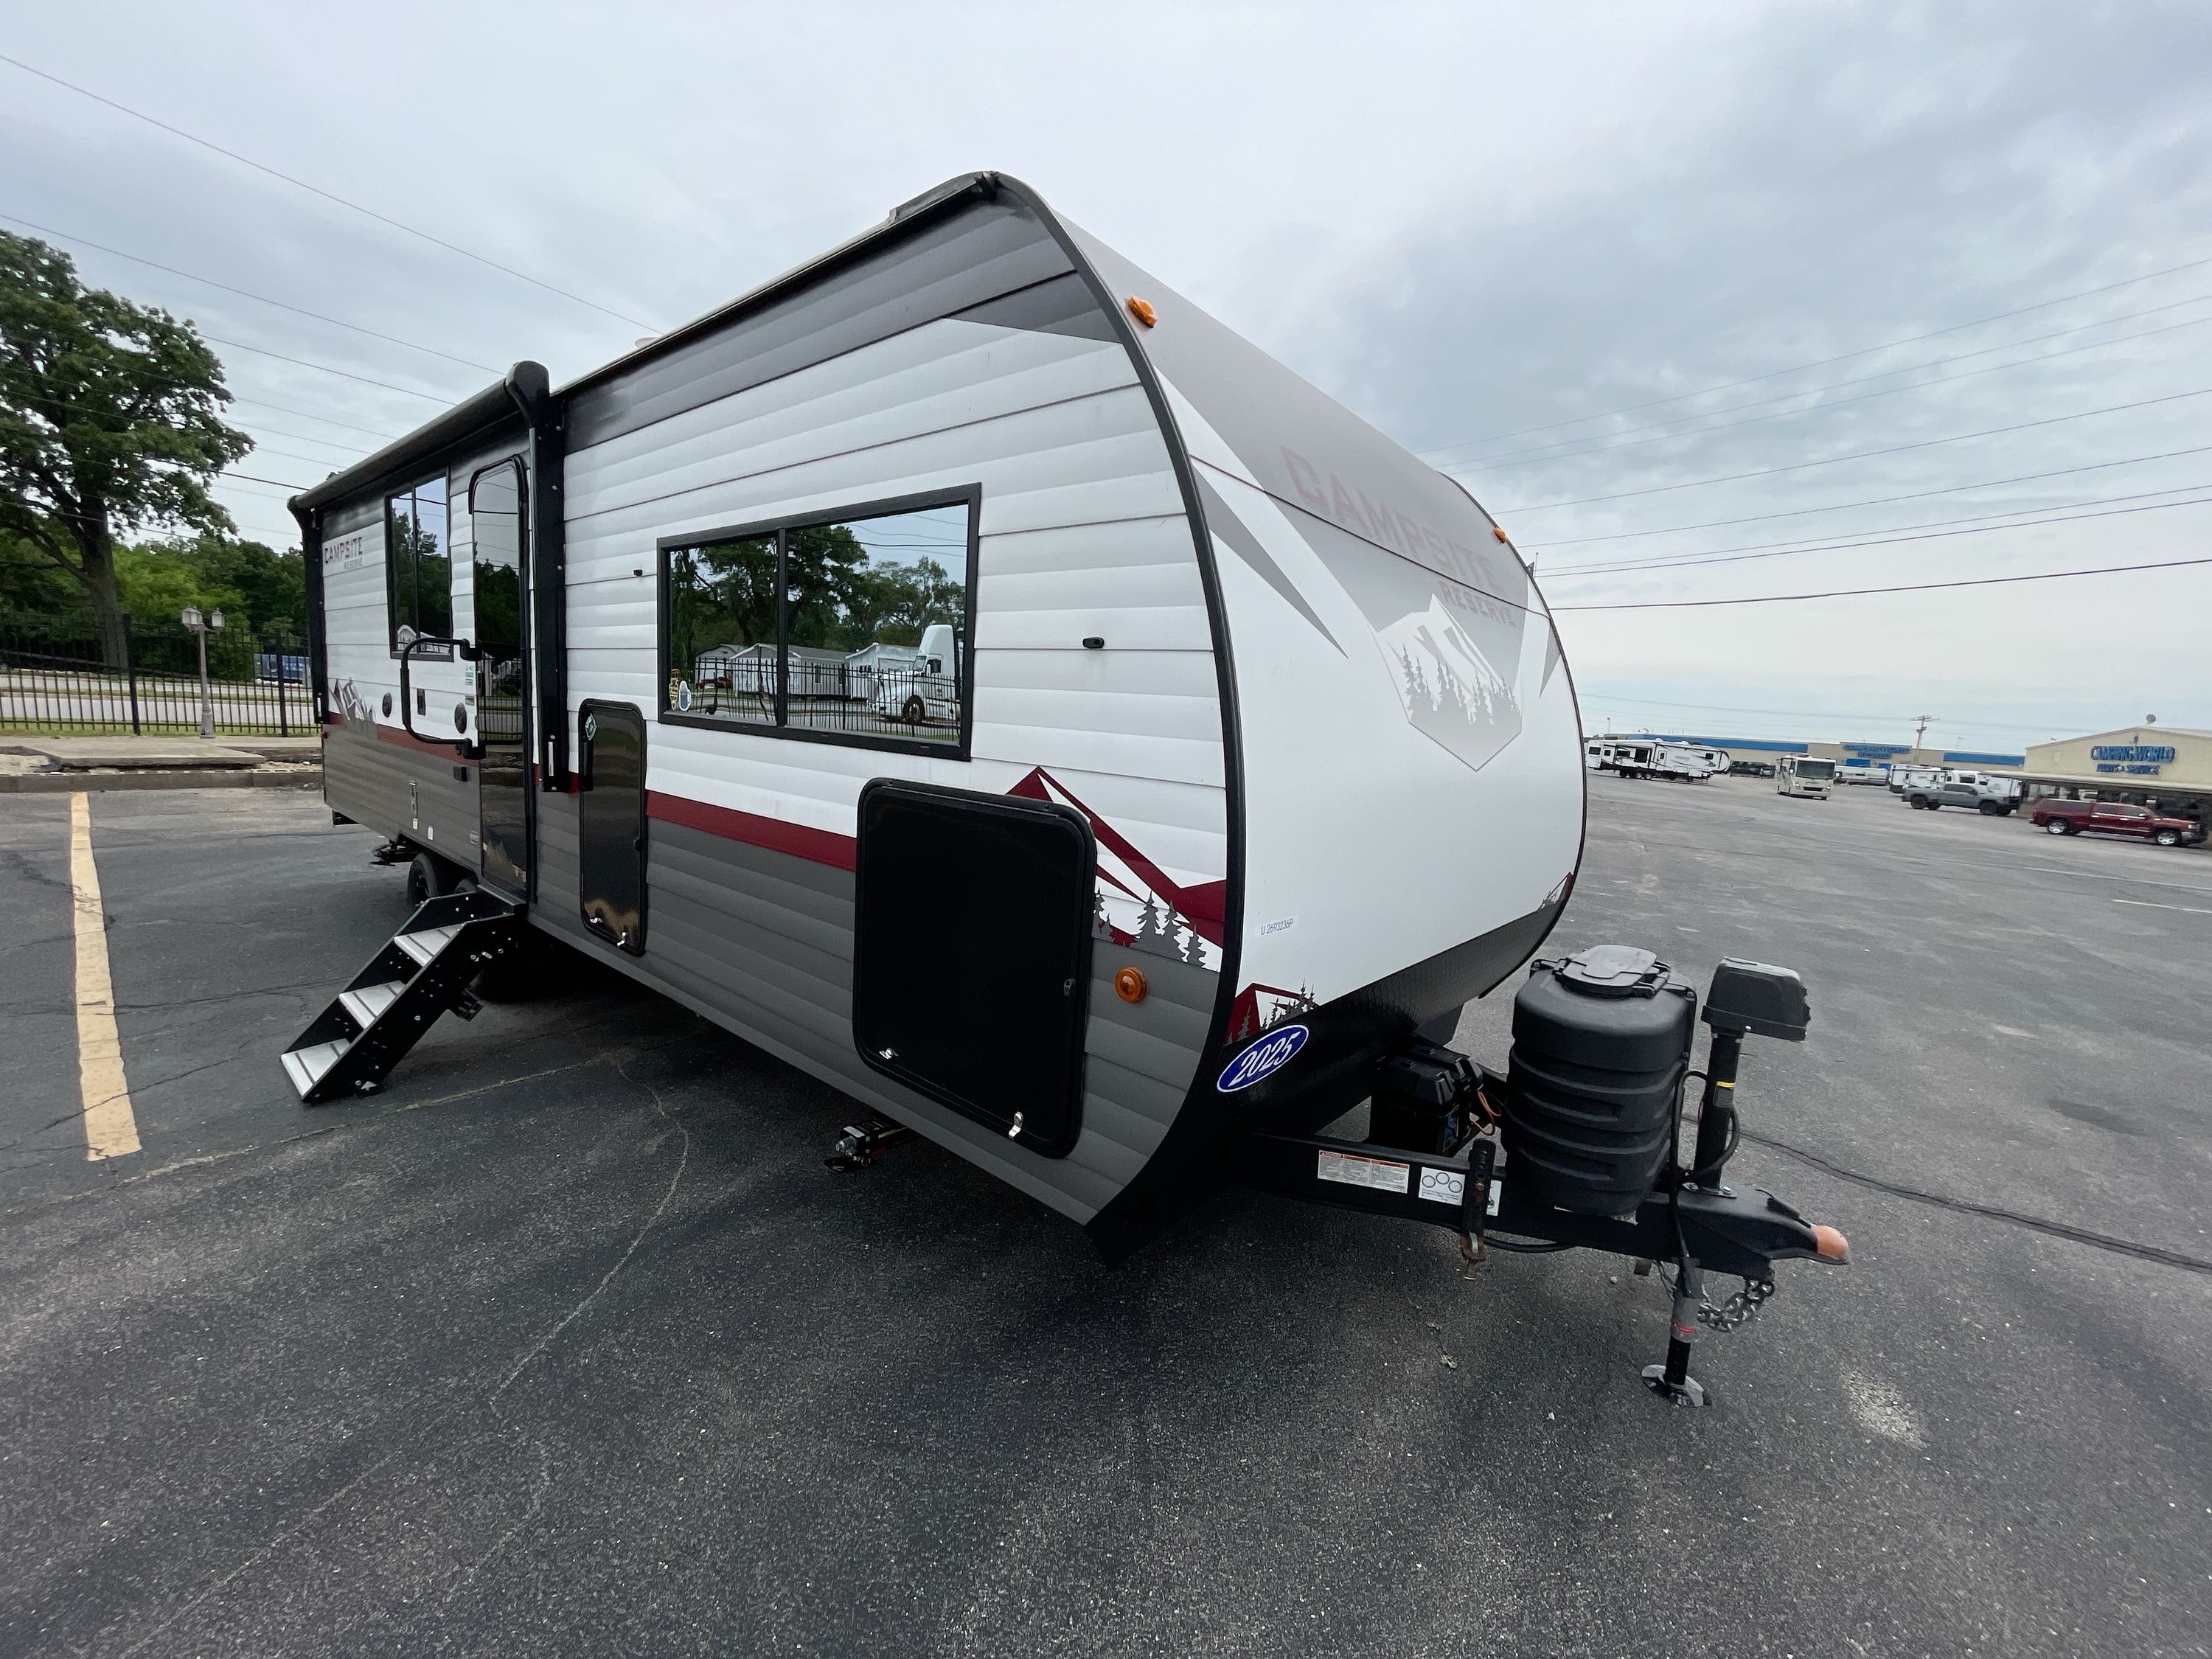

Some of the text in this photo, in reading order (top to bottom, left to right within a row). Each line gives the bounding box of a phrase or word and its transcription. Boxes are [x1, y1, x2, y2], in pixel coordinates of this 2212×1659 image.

[1280, 446, 1507, 593] CAMPSITE
[324, 537, 362, 564] CAMPSITE
[1439, 580, 1516, 627] RESERVE
[1261, 925, 1265, 935] U
[1228, 1031, 1301, 1087] 2025
